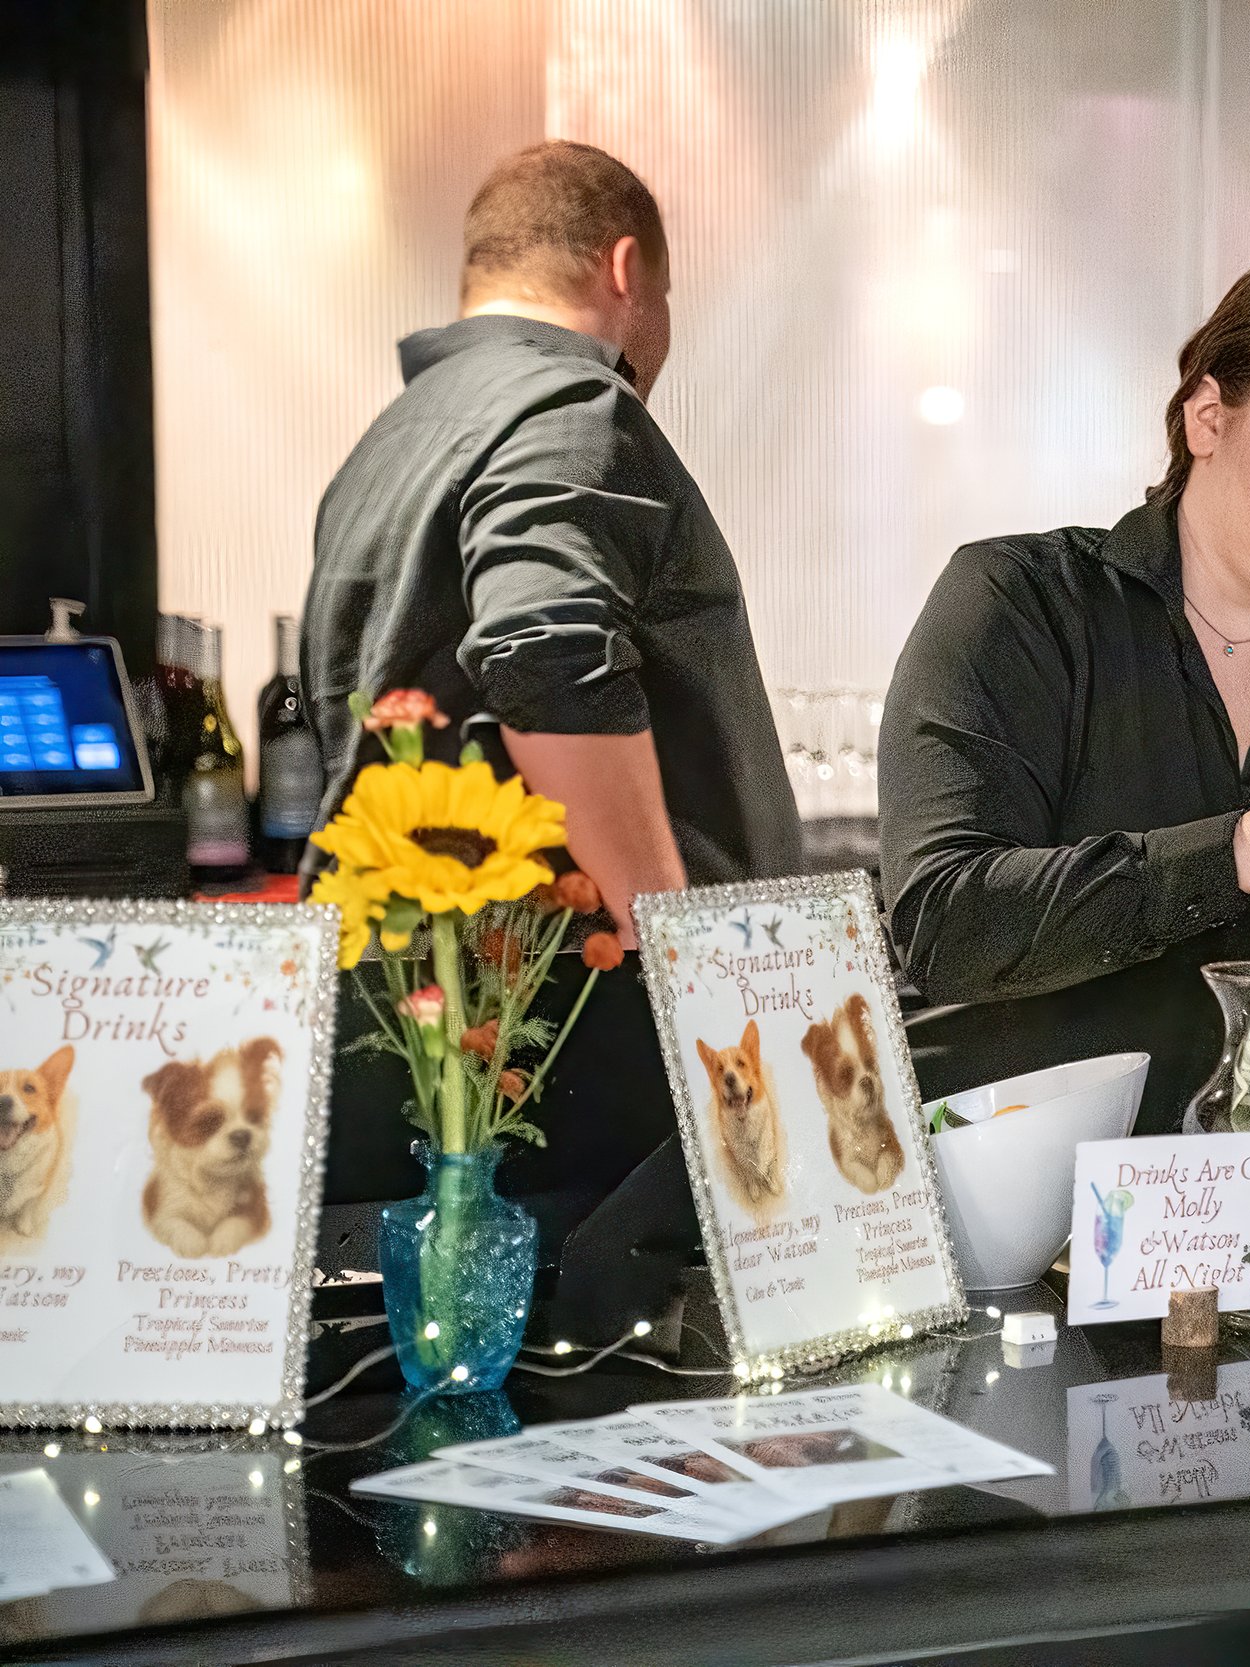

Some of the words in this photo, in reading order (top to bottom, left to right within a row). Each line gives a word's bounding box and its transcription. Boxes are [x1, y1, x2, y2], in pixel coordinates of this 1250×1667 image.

[31, 963, 210, 1009] Signature
[708, 947, 814, 988] Signature
[741, 972, 814, 1021] Drinks
[61, 1001, 188, 1057] Drinks
[1118, 1153, 1188, 1194] Drinks
[1194, 1158, 1235, 1182] Are
[1163, 1186, 1222, 1224] Molly
[725, 1219, 799, 1249] lementary,
[862, 1217, 913, 1241] Princess
[1131, 1259, 1167, 1291] All
[1170, 1253, 1245, 1289] Night
[0, 1286, 70, 1308] atson
[157, 1287, 248, 1309] Princess
